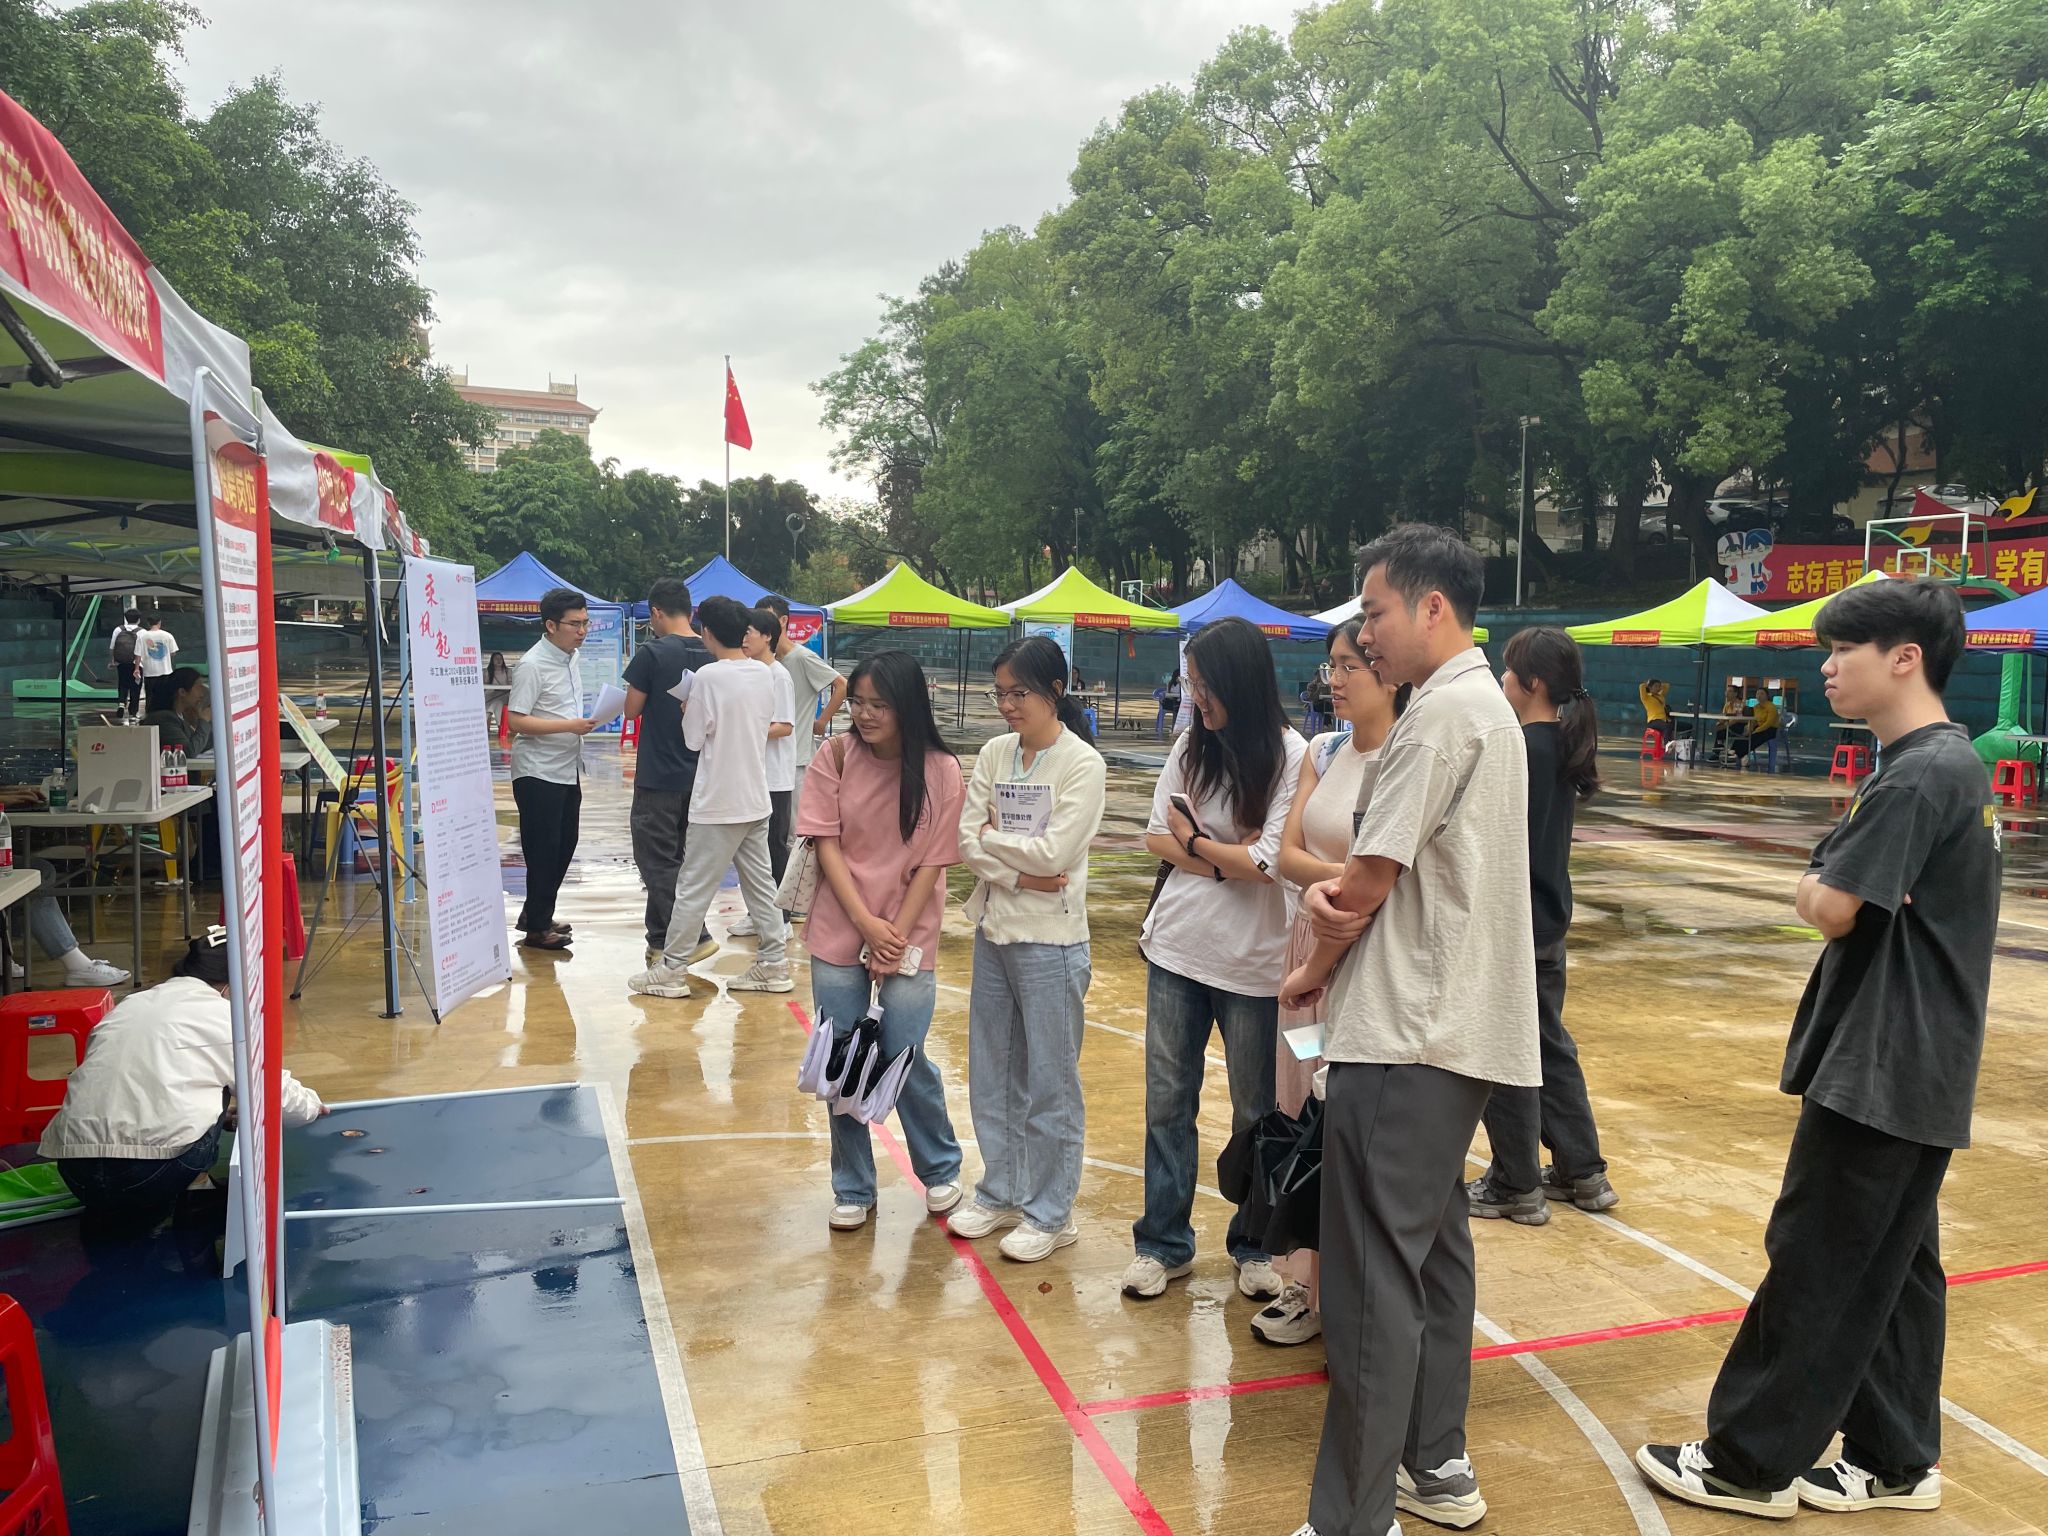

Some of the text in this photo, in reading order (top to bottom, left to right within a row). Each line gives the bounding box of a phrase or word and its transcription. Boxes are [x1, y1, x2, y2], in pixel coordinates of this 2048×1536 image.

[1787, 559, 1864, 594] 志存高远
[1995, 547, 2048, 588] 学有
